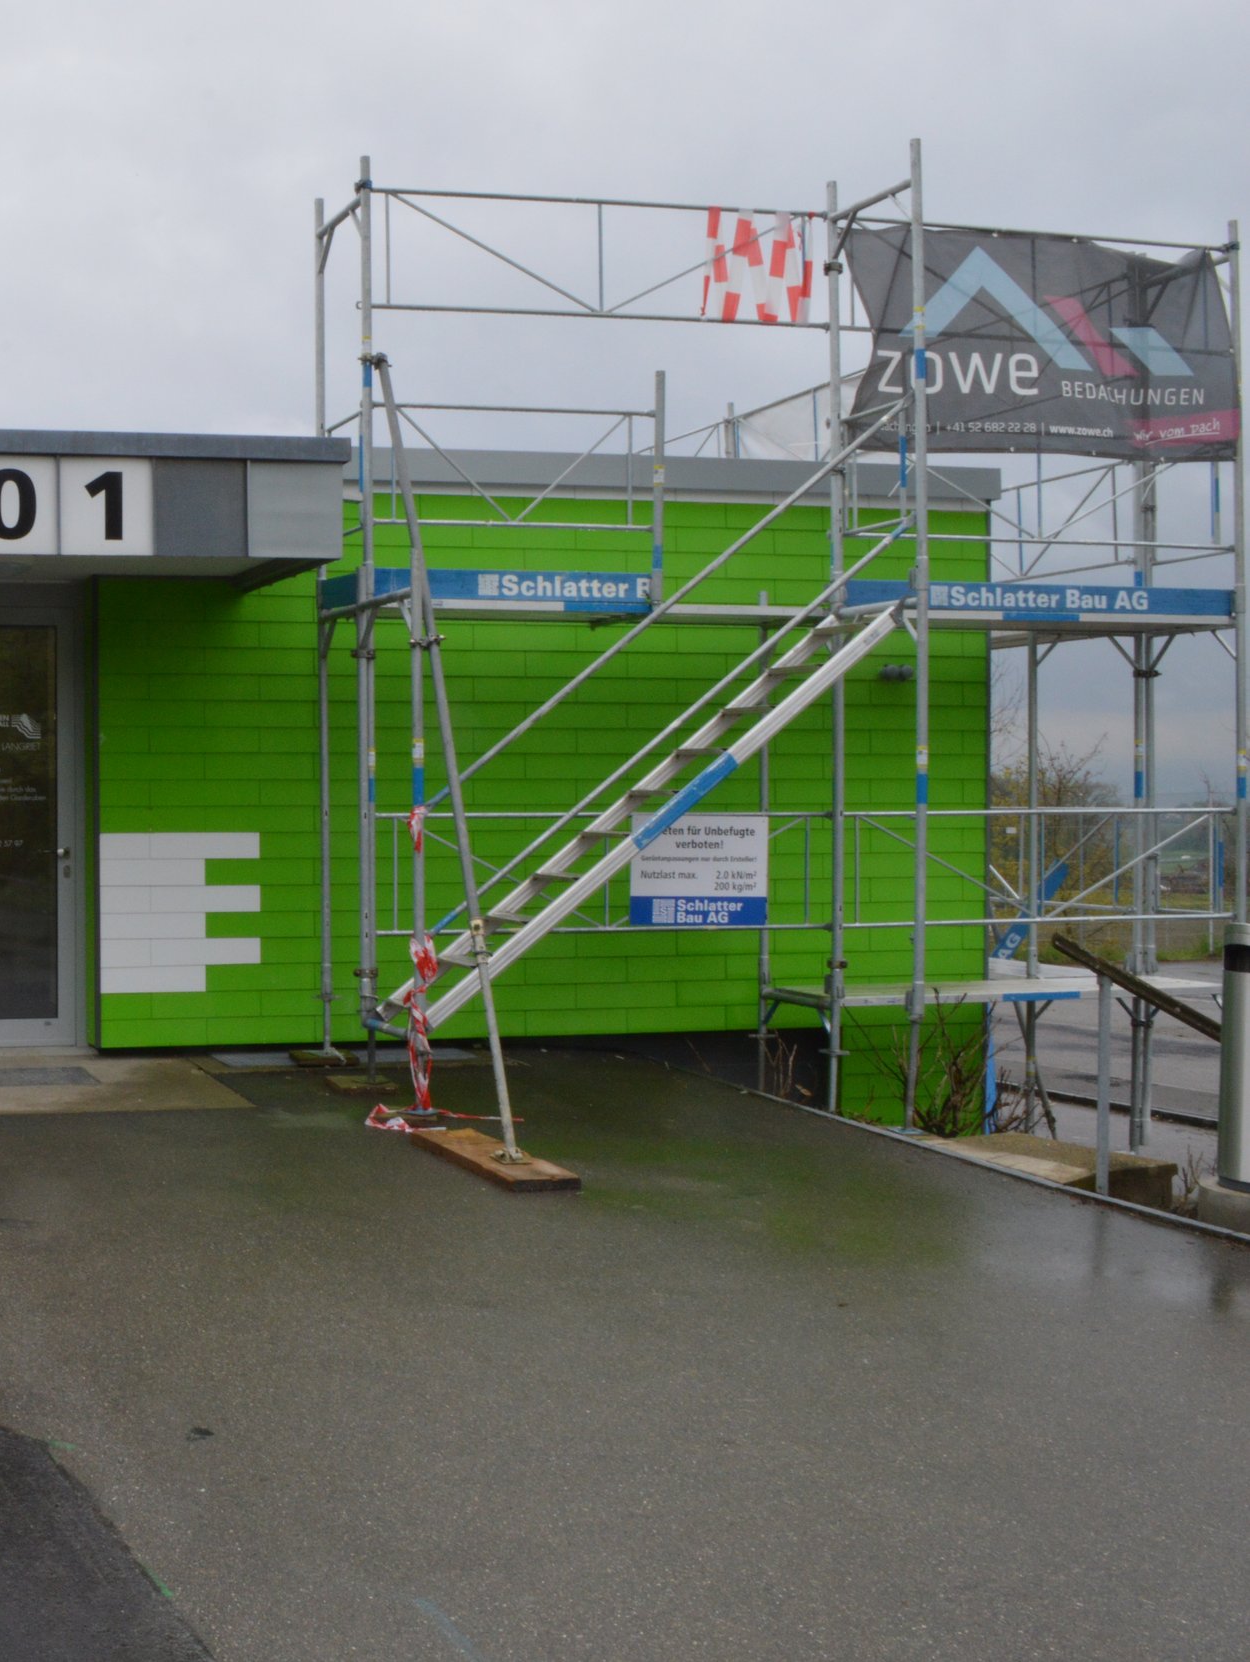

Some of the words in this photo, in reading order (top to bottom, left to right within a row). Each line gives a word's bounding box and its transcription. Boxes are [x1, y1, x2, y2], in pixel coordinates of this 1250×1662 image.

[877, 349, 1039, 396] zowe
[1060, 380, 1205, 406] BEDACHUNGEN
[946, 422, 965, 433] +41
[968, 422, 982, 433] 52
[984, 422, 1006, 433] 682
[1007, 422, 1021, 433] 22
[1023, 422, 1037, 433] 28
[1049, 424, 1114, 438] www.zowe.ch
[501, 573, 630, 599] Schlatter
[950, 586, 1060, 609] Schlatter
[1065, 588, 1108, 609] Bau
[1114, 590, 1149, 610] AG
[661, 826, 685, 836] eten
[687, 825, 701, 836] für
[704, 826, 756, 838] Unbefugte
[675, 840, 724, 849] verboten!
[640, 869, 676, 879] Nutzlast
[678, 871, 698, 879] max.
[715, 870, 729, 880] 2.0
[714, 882, 730, 891] 200
[732, 882, 757, 893] kg/m²
[676, 899, 744, 912] Schlatter
[676, 911, 703, 923] Bau
[707, 911, 729, 923] AG
